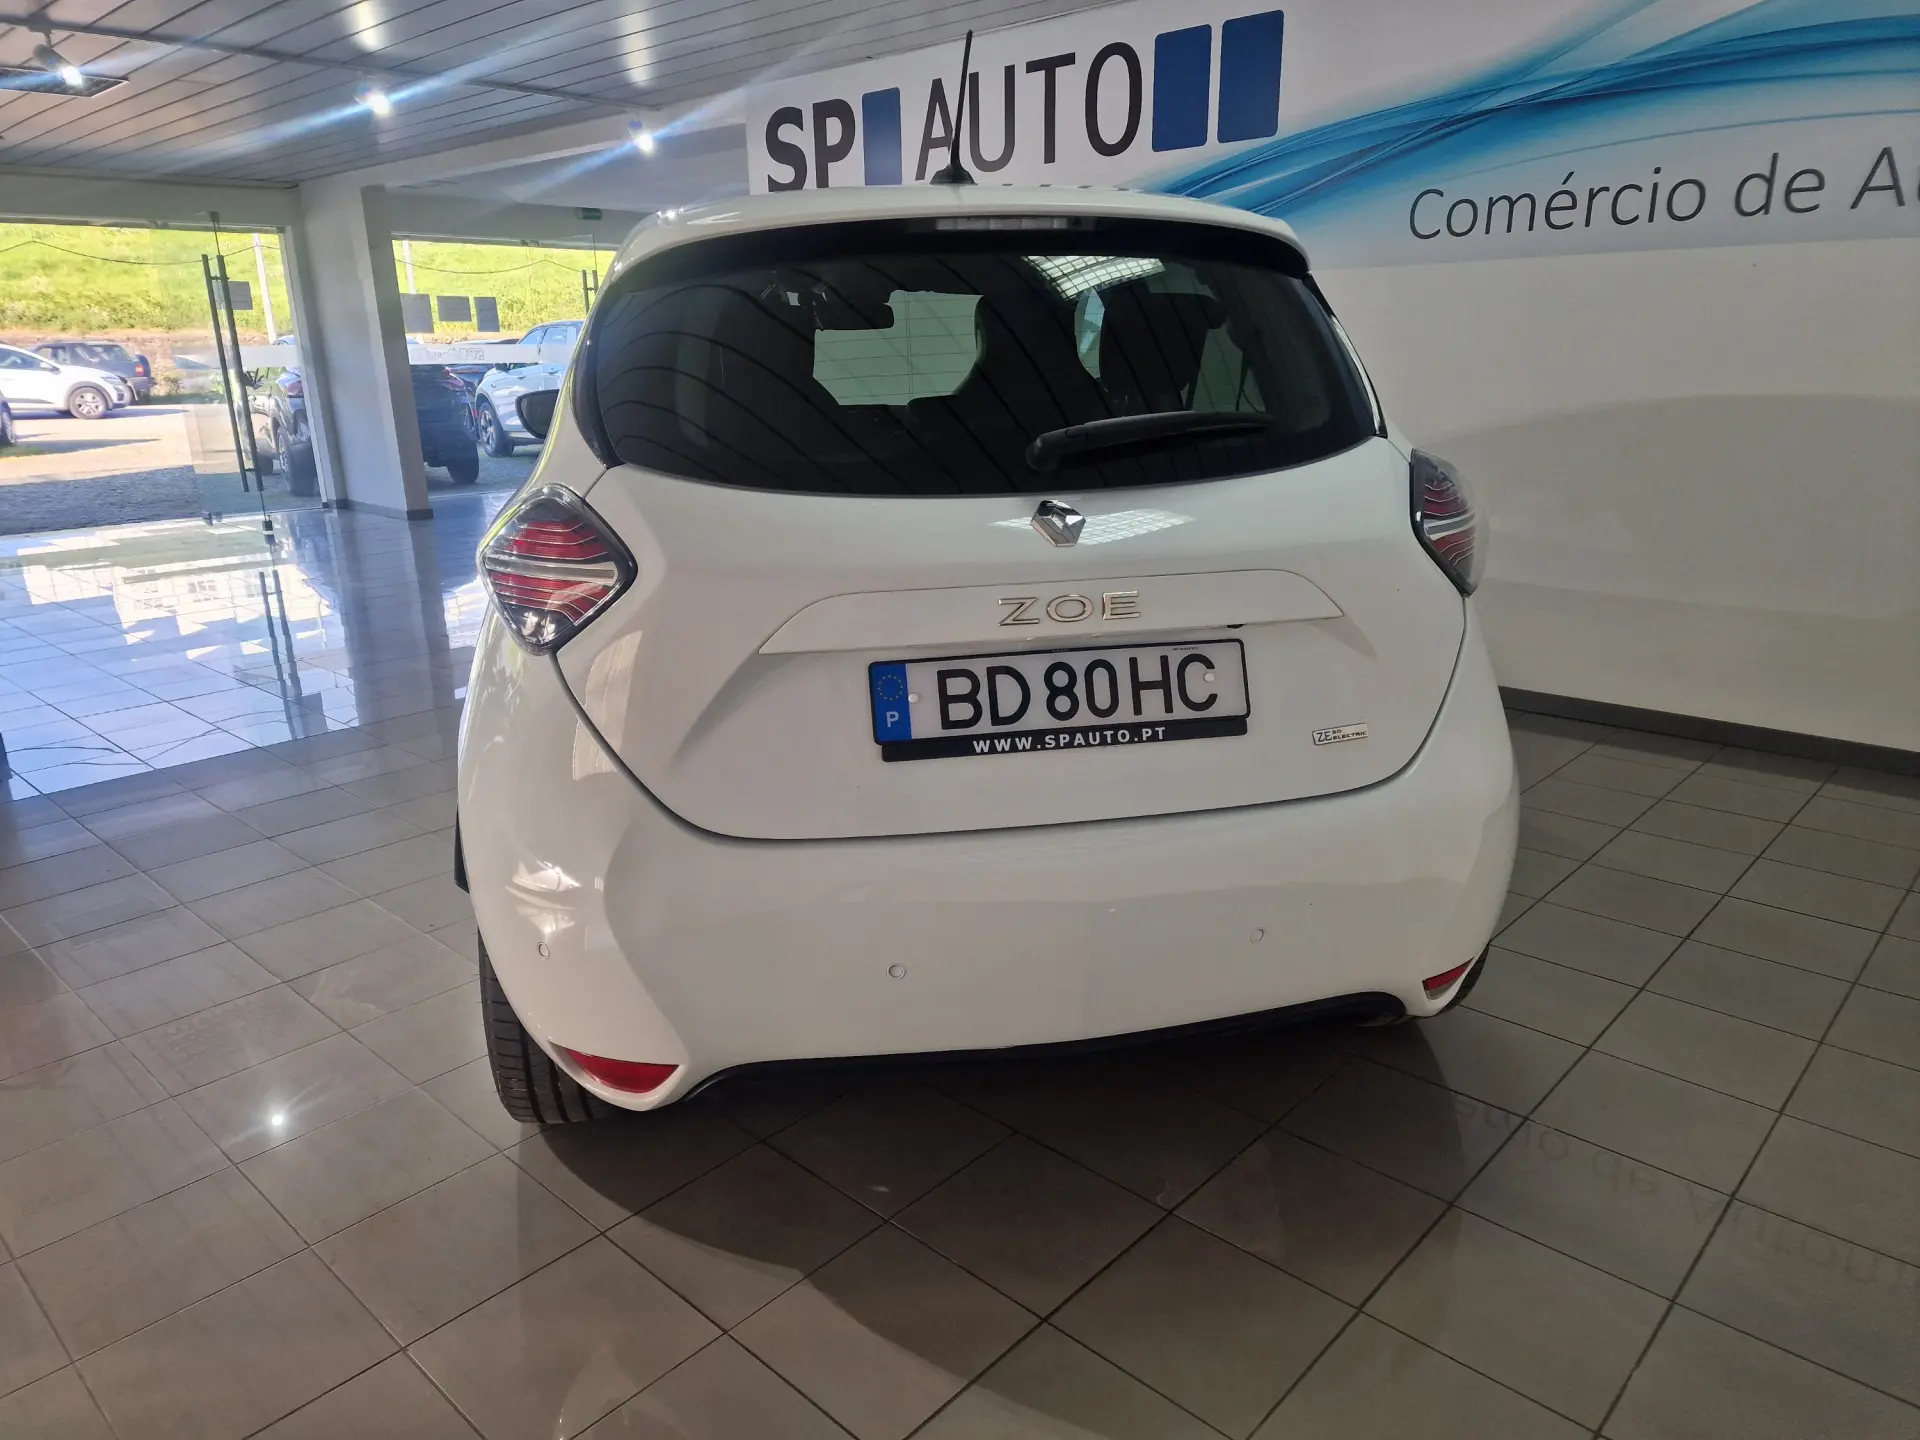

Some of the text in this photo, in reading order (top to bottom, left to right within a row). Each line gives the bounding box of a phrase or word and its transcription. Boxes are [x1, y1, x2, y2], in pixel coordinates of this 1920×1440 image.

[765, 41, 1143, 192] SP AUTO
[1409, 146, 1920, 239] Comércio de A
[997, 590, 1141, 627] ZOE
[886, 711, 899, 728] P
[973, 727, 1166, 754] WWW.SPAUTO.PT
